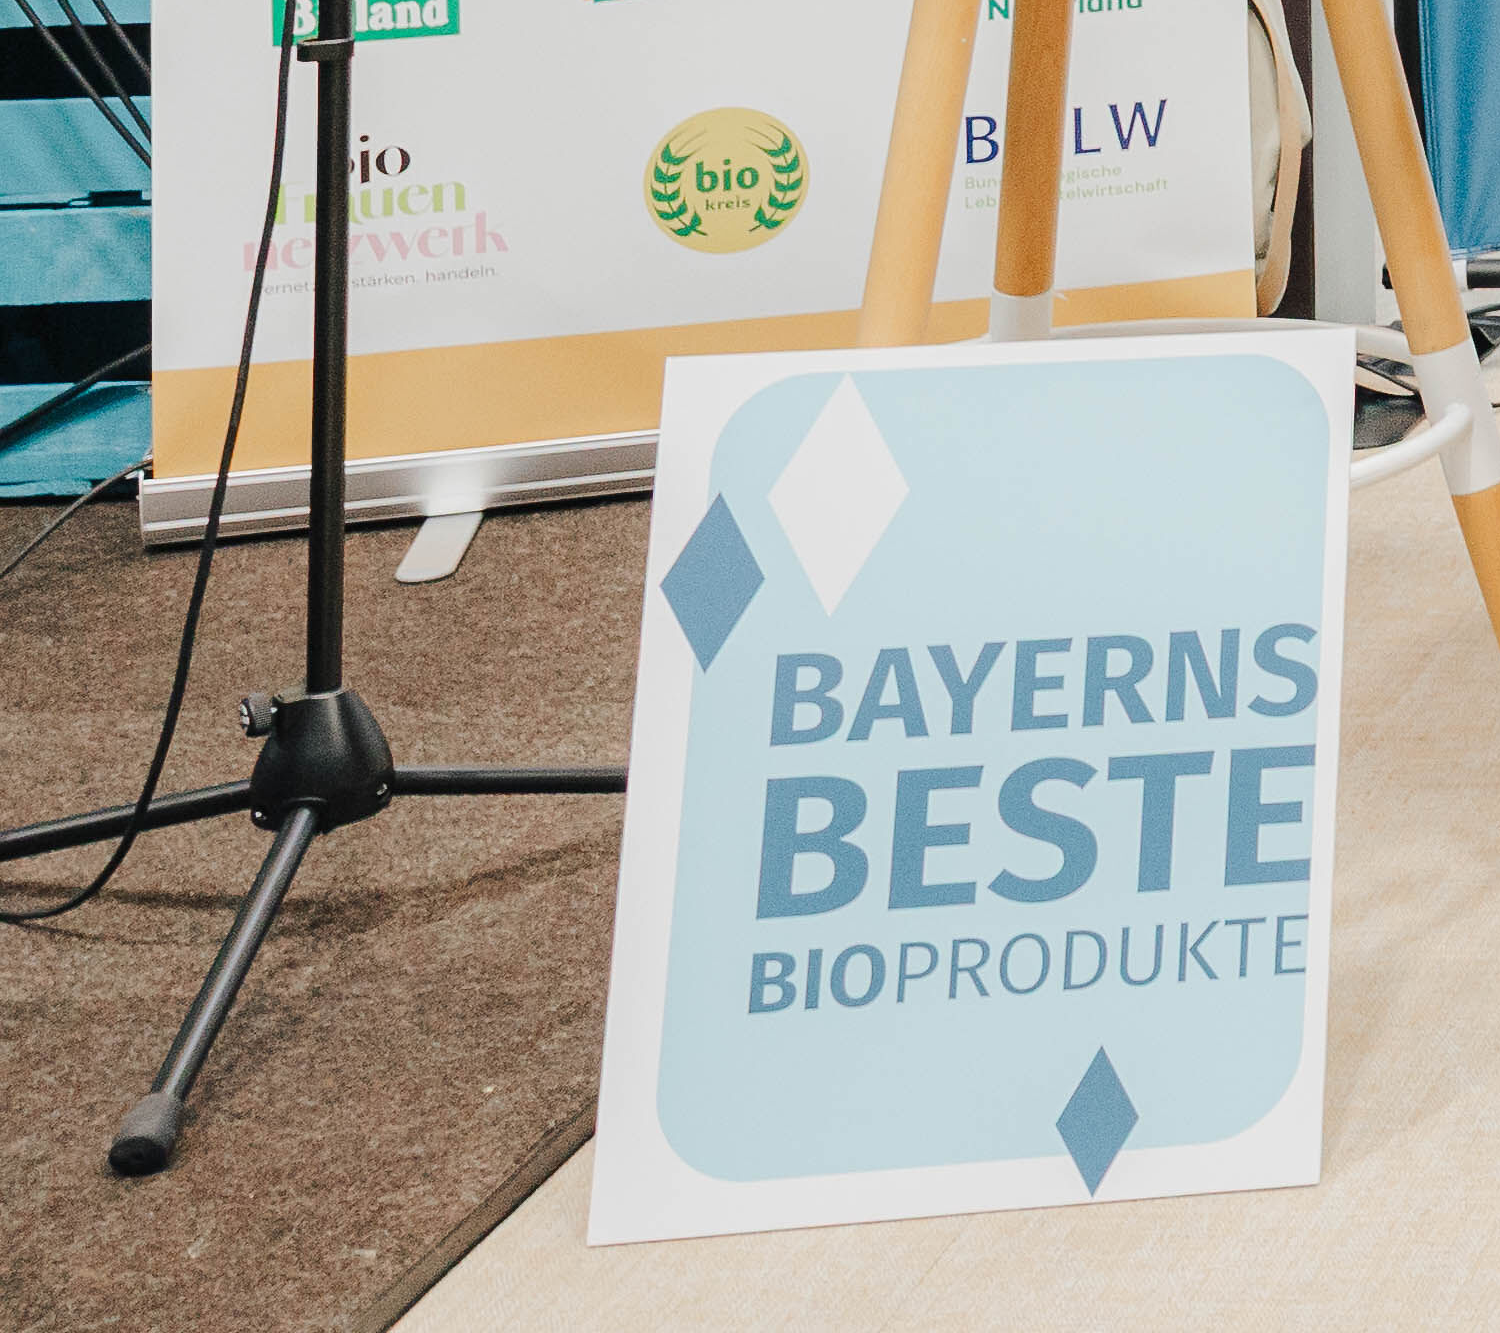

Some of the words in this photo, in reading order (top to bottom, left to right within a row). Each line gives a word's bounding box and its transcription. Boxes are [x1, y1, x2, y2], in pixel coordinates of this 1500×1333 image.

[349, 135, 411, 183] io
[965, 98, 1168, 164] BLW
[695, 158, 760, 193] bio
[705, 196, 751, 212] kreis
[965, 175, 1000, 190] Bun
[1060, 166, 1122, 183] gische
[243, 211, 509, 272] nezwerk
[769, 623, 1318, 747] BAYERNS
[756, 744, 1316, 919] BESTE
[748, 914, 1309, 1015] BIOPRODUKTE
